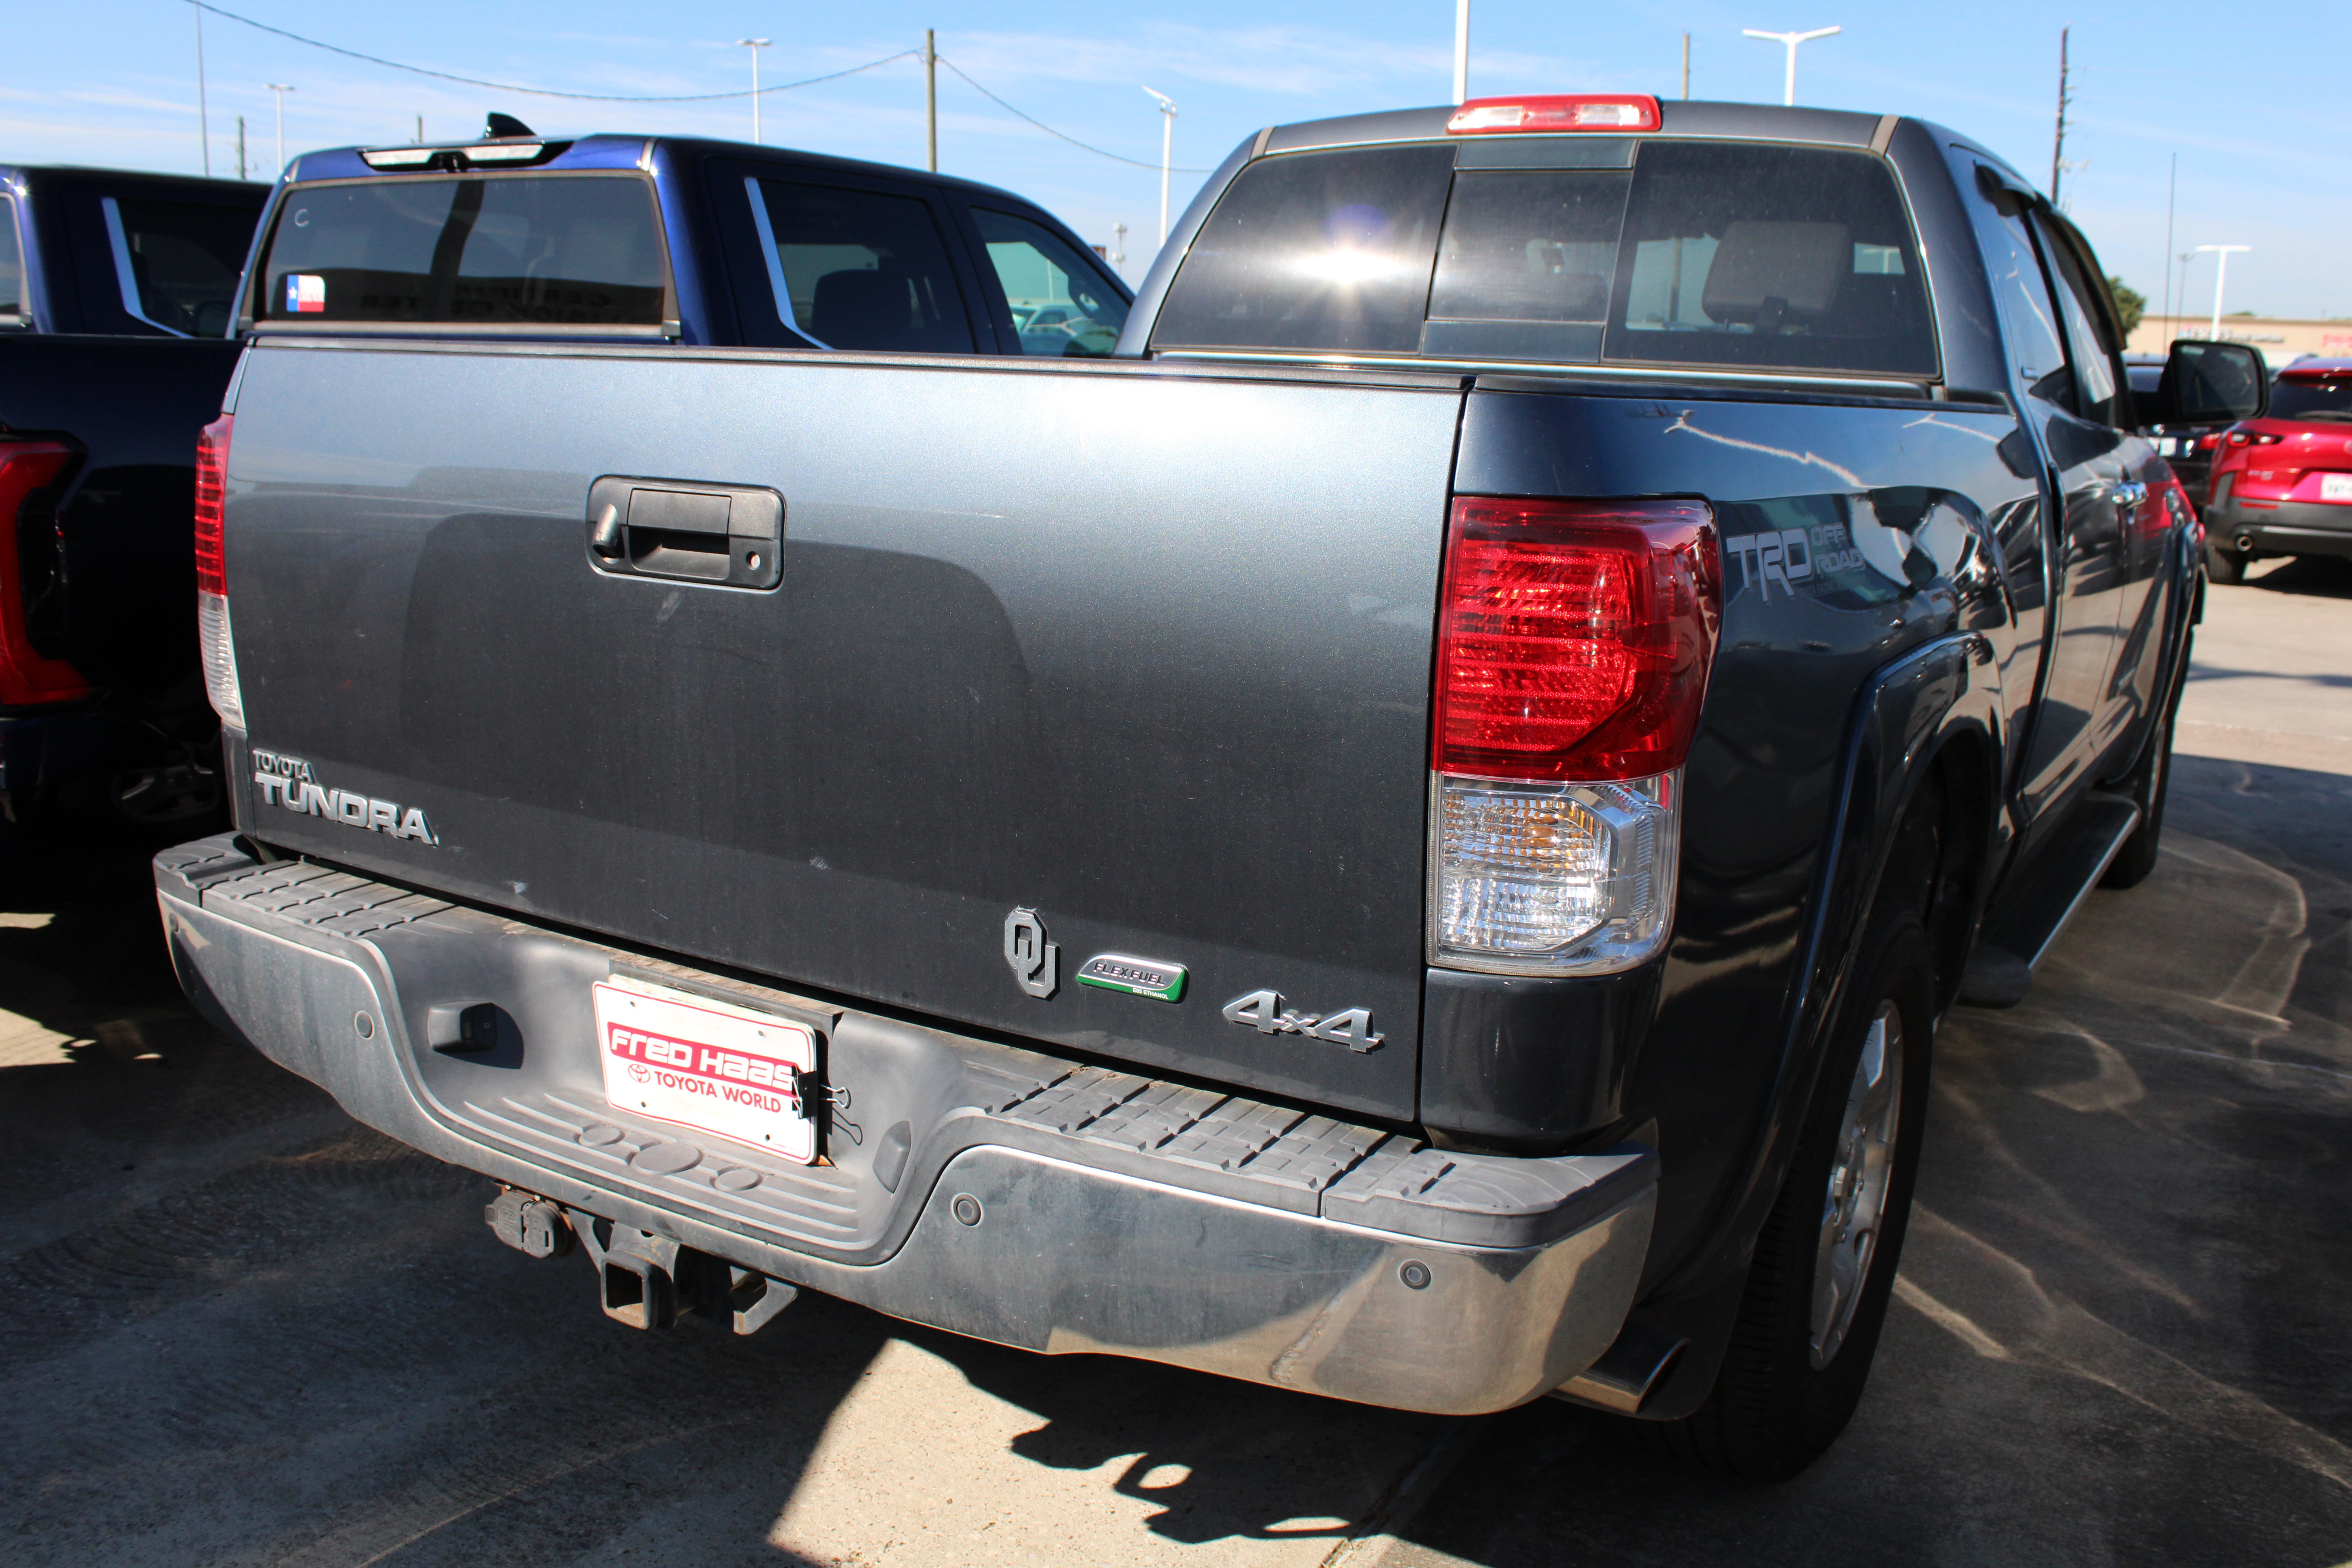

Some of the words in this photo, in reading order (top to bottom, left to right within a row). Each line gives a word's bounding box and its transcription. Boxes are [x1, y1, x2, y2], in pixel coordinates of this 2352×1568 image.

[1811, 522, 1846, 548] OFF
[1726, 528, 1812, 602] TRD
[1814, 547, 1866, 575] ROAD
[252, 748, 315, 784] TOYOTA
[254, 771, 439, 847] TUNDRA
[1093, 962, 1130, 979] FLEX
[1129, 969, 1165, 987] FUEL
[1143, 989, 1169, 1000] ETHANOL
[1222, 989, 1383, 1053] 4x4
[654, 1071, 718, 1098] TOYOTA
[722, 1085, 781, 1113] WORLD
